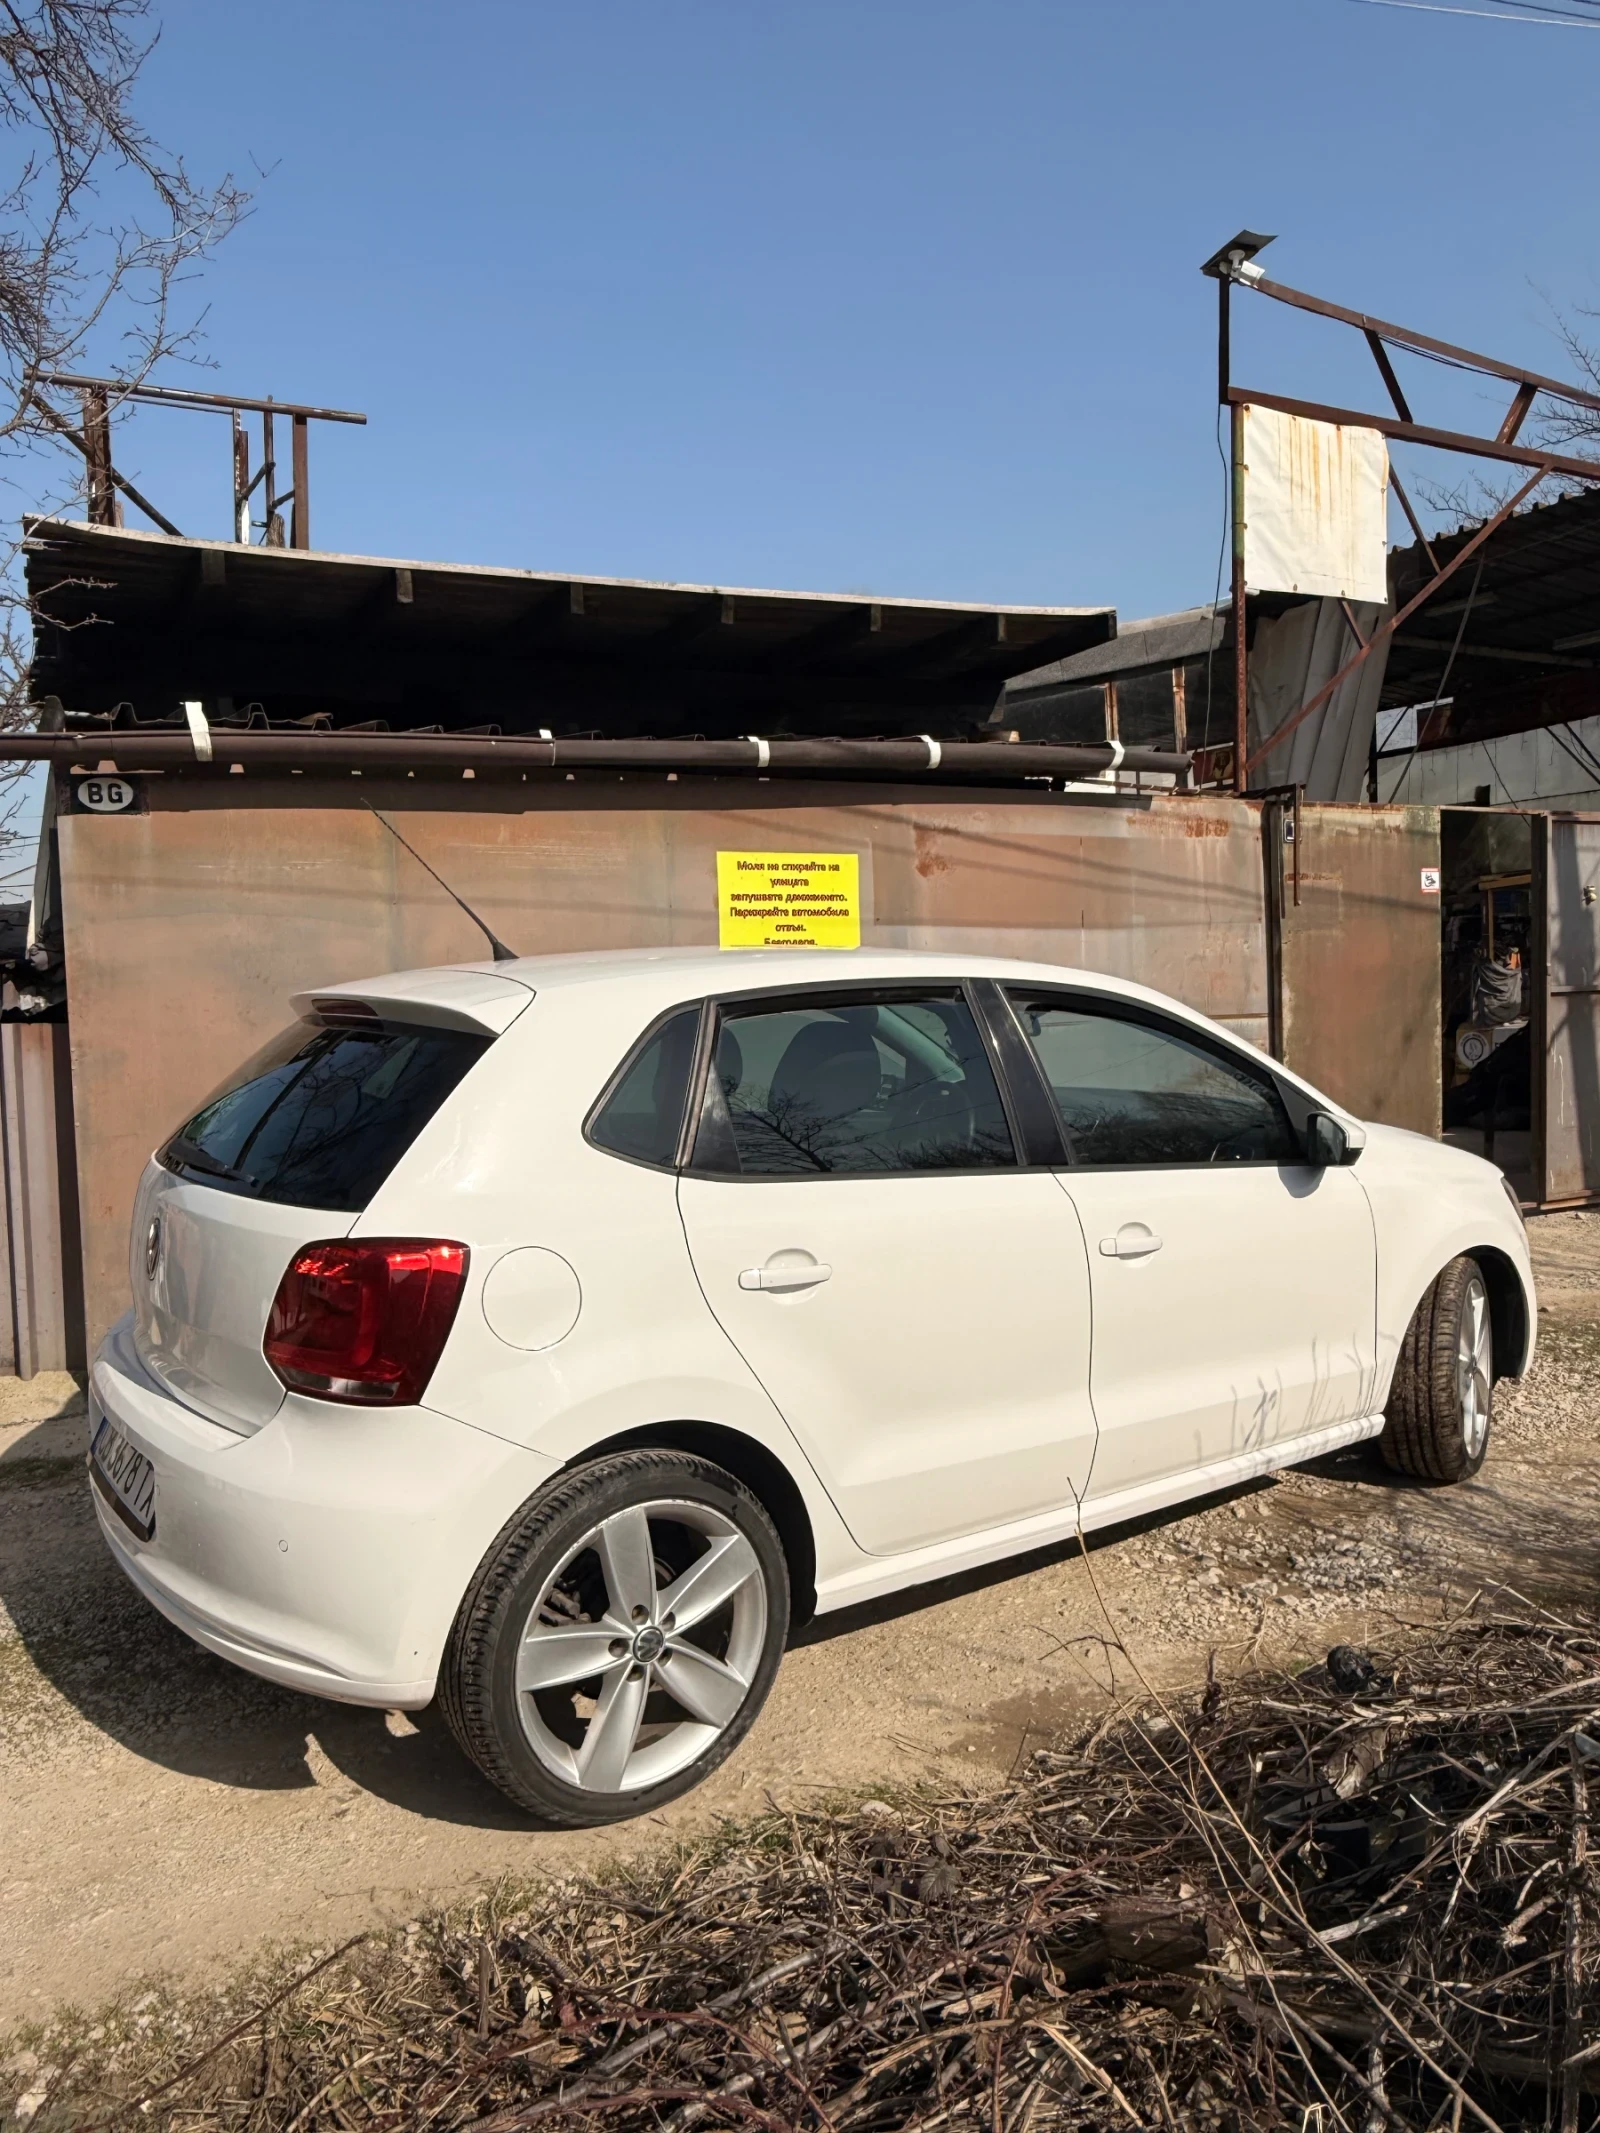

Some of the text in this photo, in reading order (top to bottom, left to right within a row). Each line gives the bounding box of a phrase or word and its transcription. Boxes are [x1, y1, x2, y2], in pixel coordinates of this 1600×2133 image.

[87, 783, 123, 803] BG
[737, 861, 764, 872] Моля
[782, 862, 825, 873] спирайте
[829, 864, 840, 872] на
